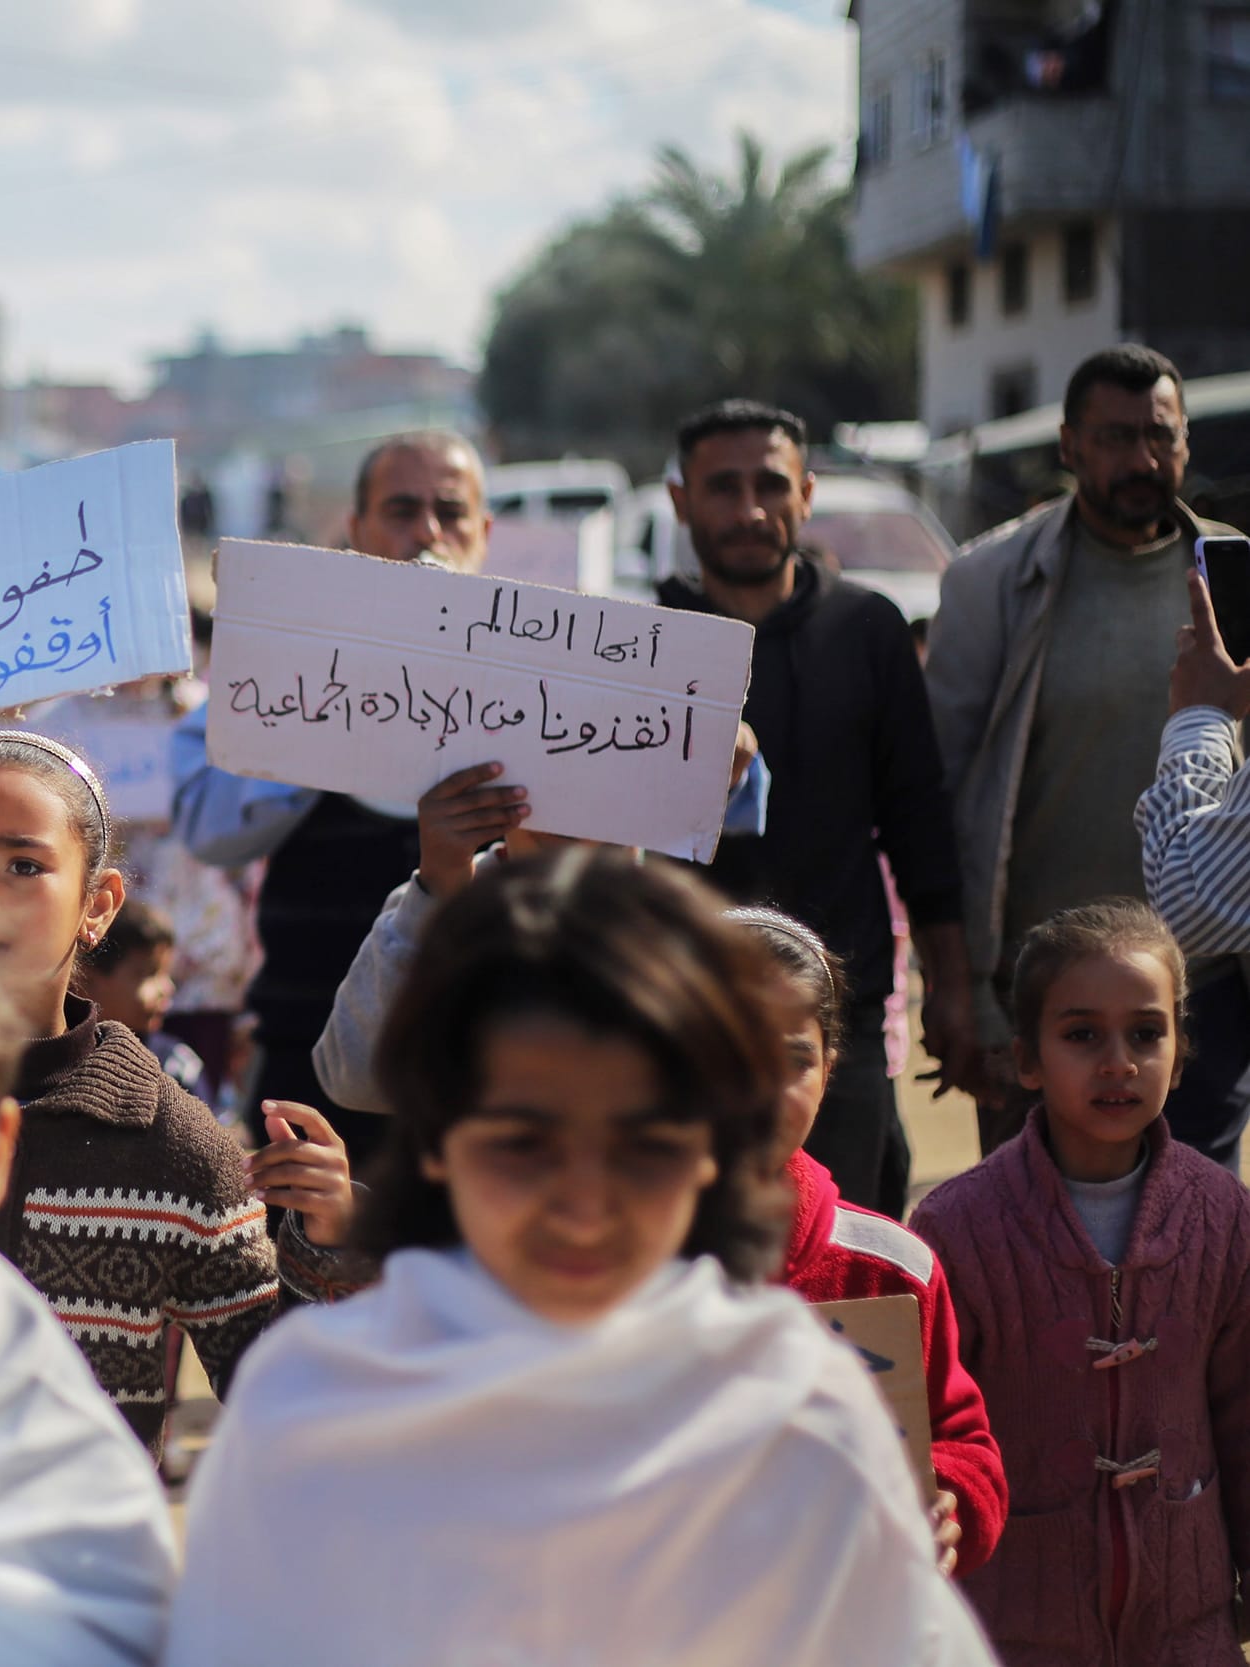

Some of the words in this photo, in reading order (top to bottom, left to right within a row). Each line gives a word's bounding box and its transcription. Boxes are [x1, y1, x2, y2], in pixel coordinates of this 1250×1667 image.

[593, 610, 663, 668] أيها
[228, 648, 352, 728] الجماعية
[360, 664, 474, 752] الإبادة
[480, 699, 526, 733] من
[539, 679, 699, 762] أنقذونا
